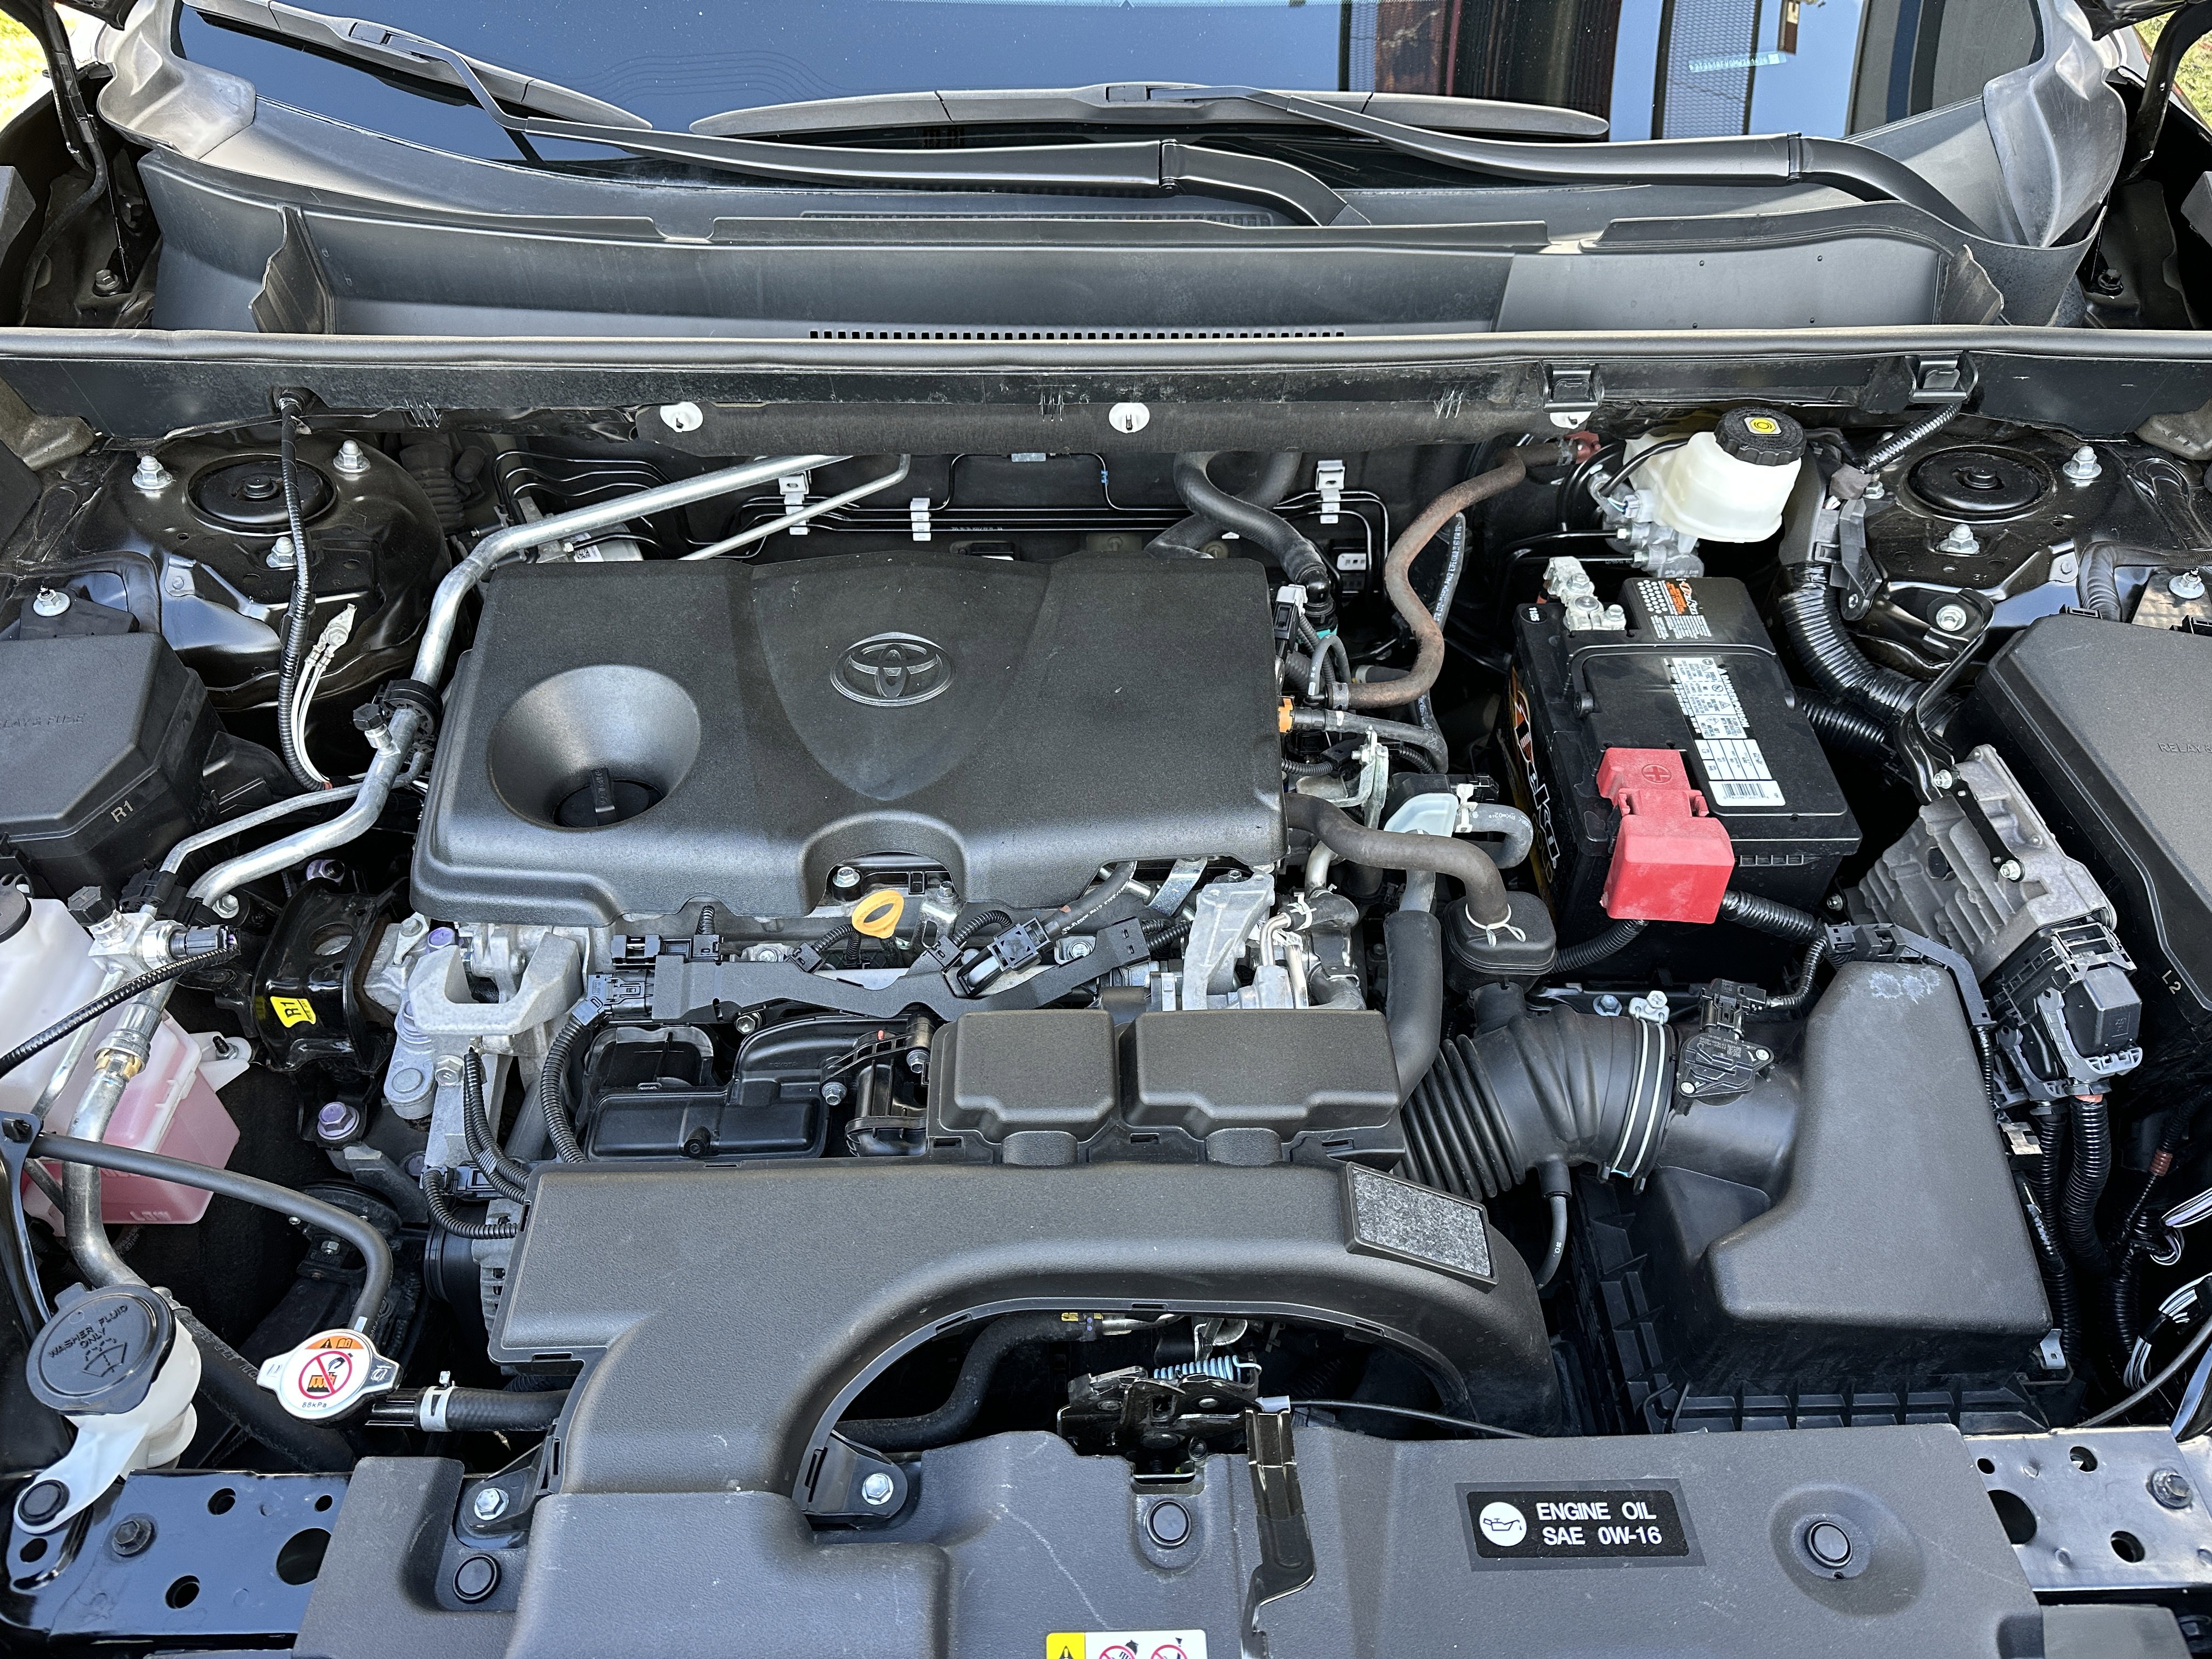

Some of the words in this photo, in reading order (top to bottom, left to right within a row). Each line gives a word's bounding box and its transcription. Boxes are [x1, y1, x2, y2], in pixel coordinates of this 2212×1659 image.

[1720, 674, 1750, 727] DANGER/POISON
[2157, 742, 2202, 753] RELAY
[110, 800, 134, 823] R1
[2162, 969, 2182, 995] L2
[280, 1001, 302, 1018] R1
[46, 1324, 94, 1358] WASHER
[98, 1304, 128, 1327] FLUID
[80, 1327, 107, 1349] ONLY
[1536, 1502, 1611, 1520] ENGINE
[1621, 1501, 1657, 1520] OIL
[1542, 1526, 1586, 1545] SAE
[1597, 1526, 1663, 1545] 0W-16
